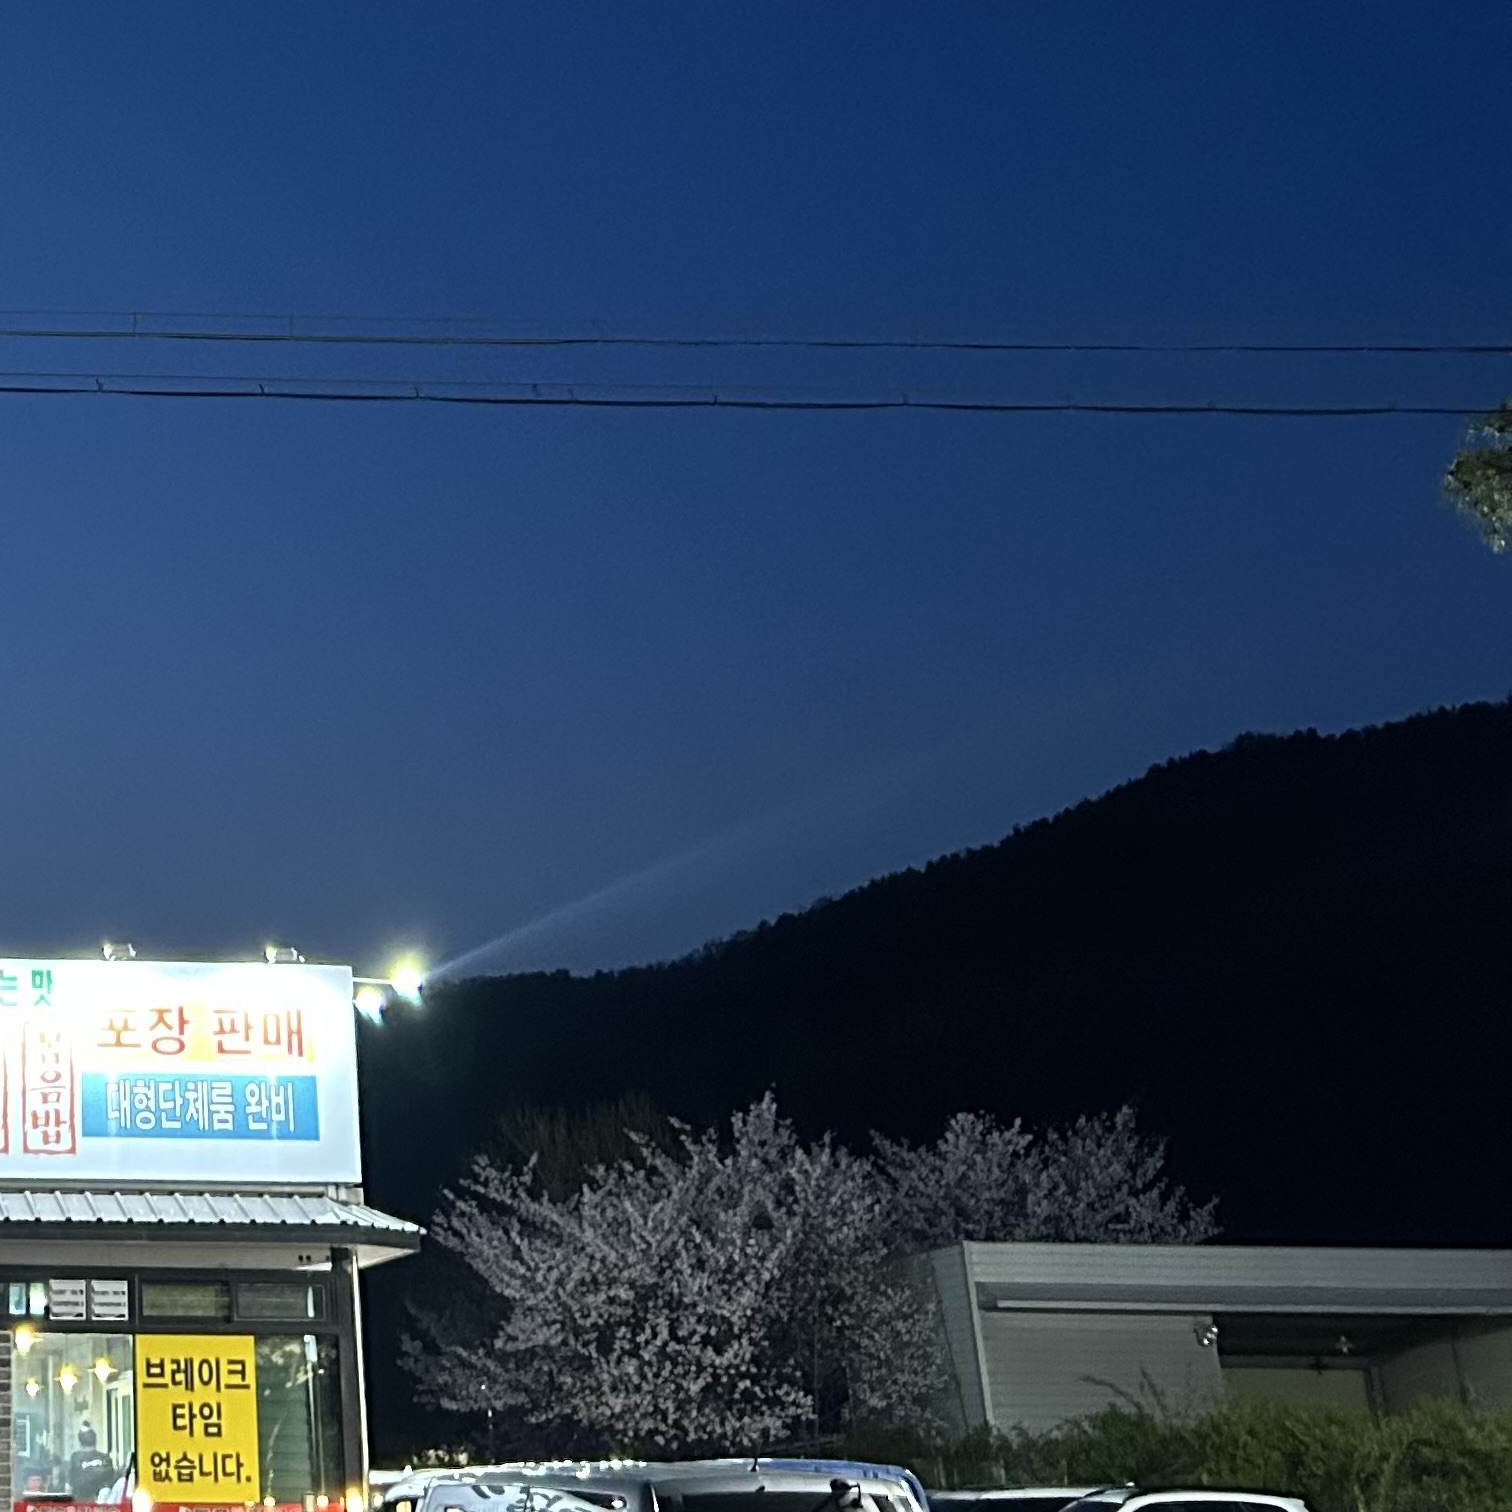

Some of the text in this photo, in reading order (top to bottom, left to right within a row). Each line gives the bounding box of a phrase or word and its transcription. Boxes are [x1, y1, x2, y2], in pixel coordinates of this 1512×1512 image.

[31, 969, 54, 1007] 맛
[96, 1005, 304, 1058] 포장 판매
[106, 1078, 296, 1134] 대형단체룸 완비
[142, 1356, 251, 1393] 브레이크
[171, 1401, 223, 1438] 타임
[150, 1451, 252, 1484] 없습니다.
